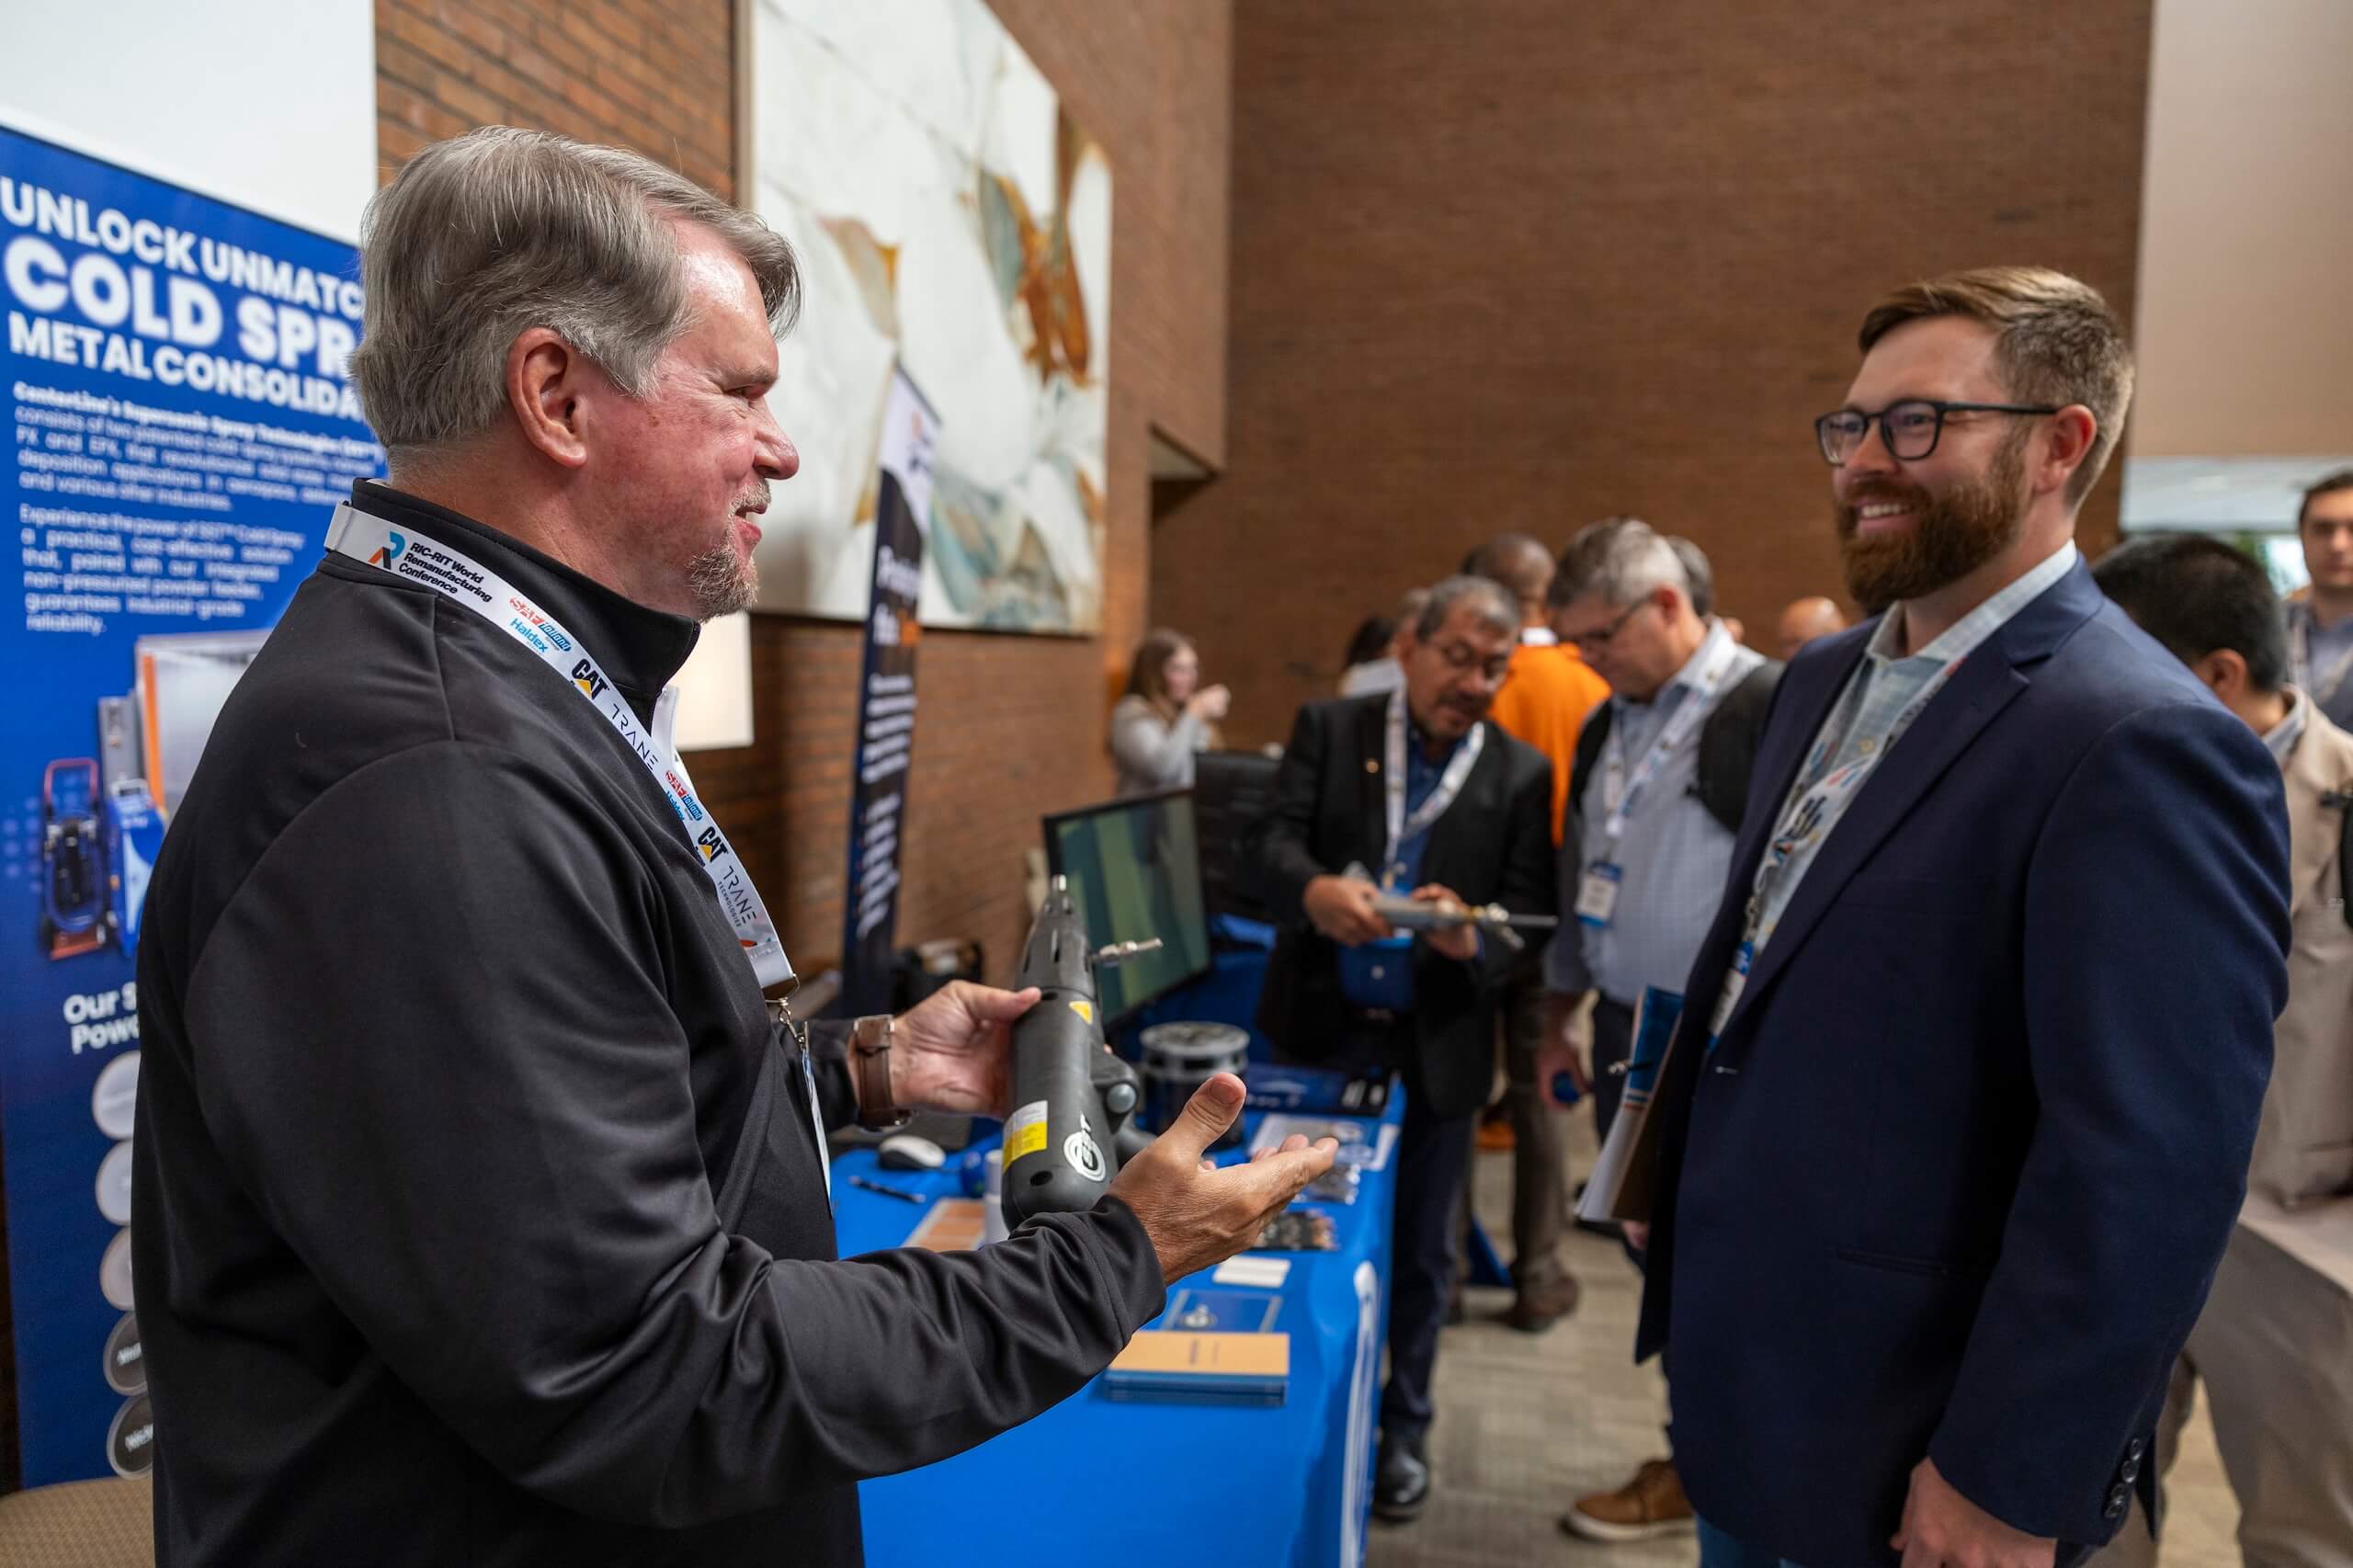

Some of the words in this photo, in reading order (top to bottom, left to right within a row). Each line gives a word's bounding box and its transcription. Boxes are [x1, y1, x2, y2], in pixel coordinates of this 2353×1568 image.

[1, 176, 198, 274] UNLOCK
[5, 235, 223, 347] COLD
[8, 311, 153, 381] METAL
[46, 432, 83, 451] and
[19, 471, 54, 491] and
[19, 503, 108, 530] Experience
[21, 528, 36, 544] a
[399, 562, 458, 594] Conference
[404, 552, 493, 603] Remanufacturing
[410, 542, 453, 566] RIC-RIT
[451, 561, 484, 584] World
[510, 618, 548, 653] Haldex
[571, 658, 609, 700] CAT
[611, 703, 658, 770] TRANE
[698, 826, 729, 863] CAT
[723, 865, 756, 924] TRANE
[63, 991, 120, 1025] Our
